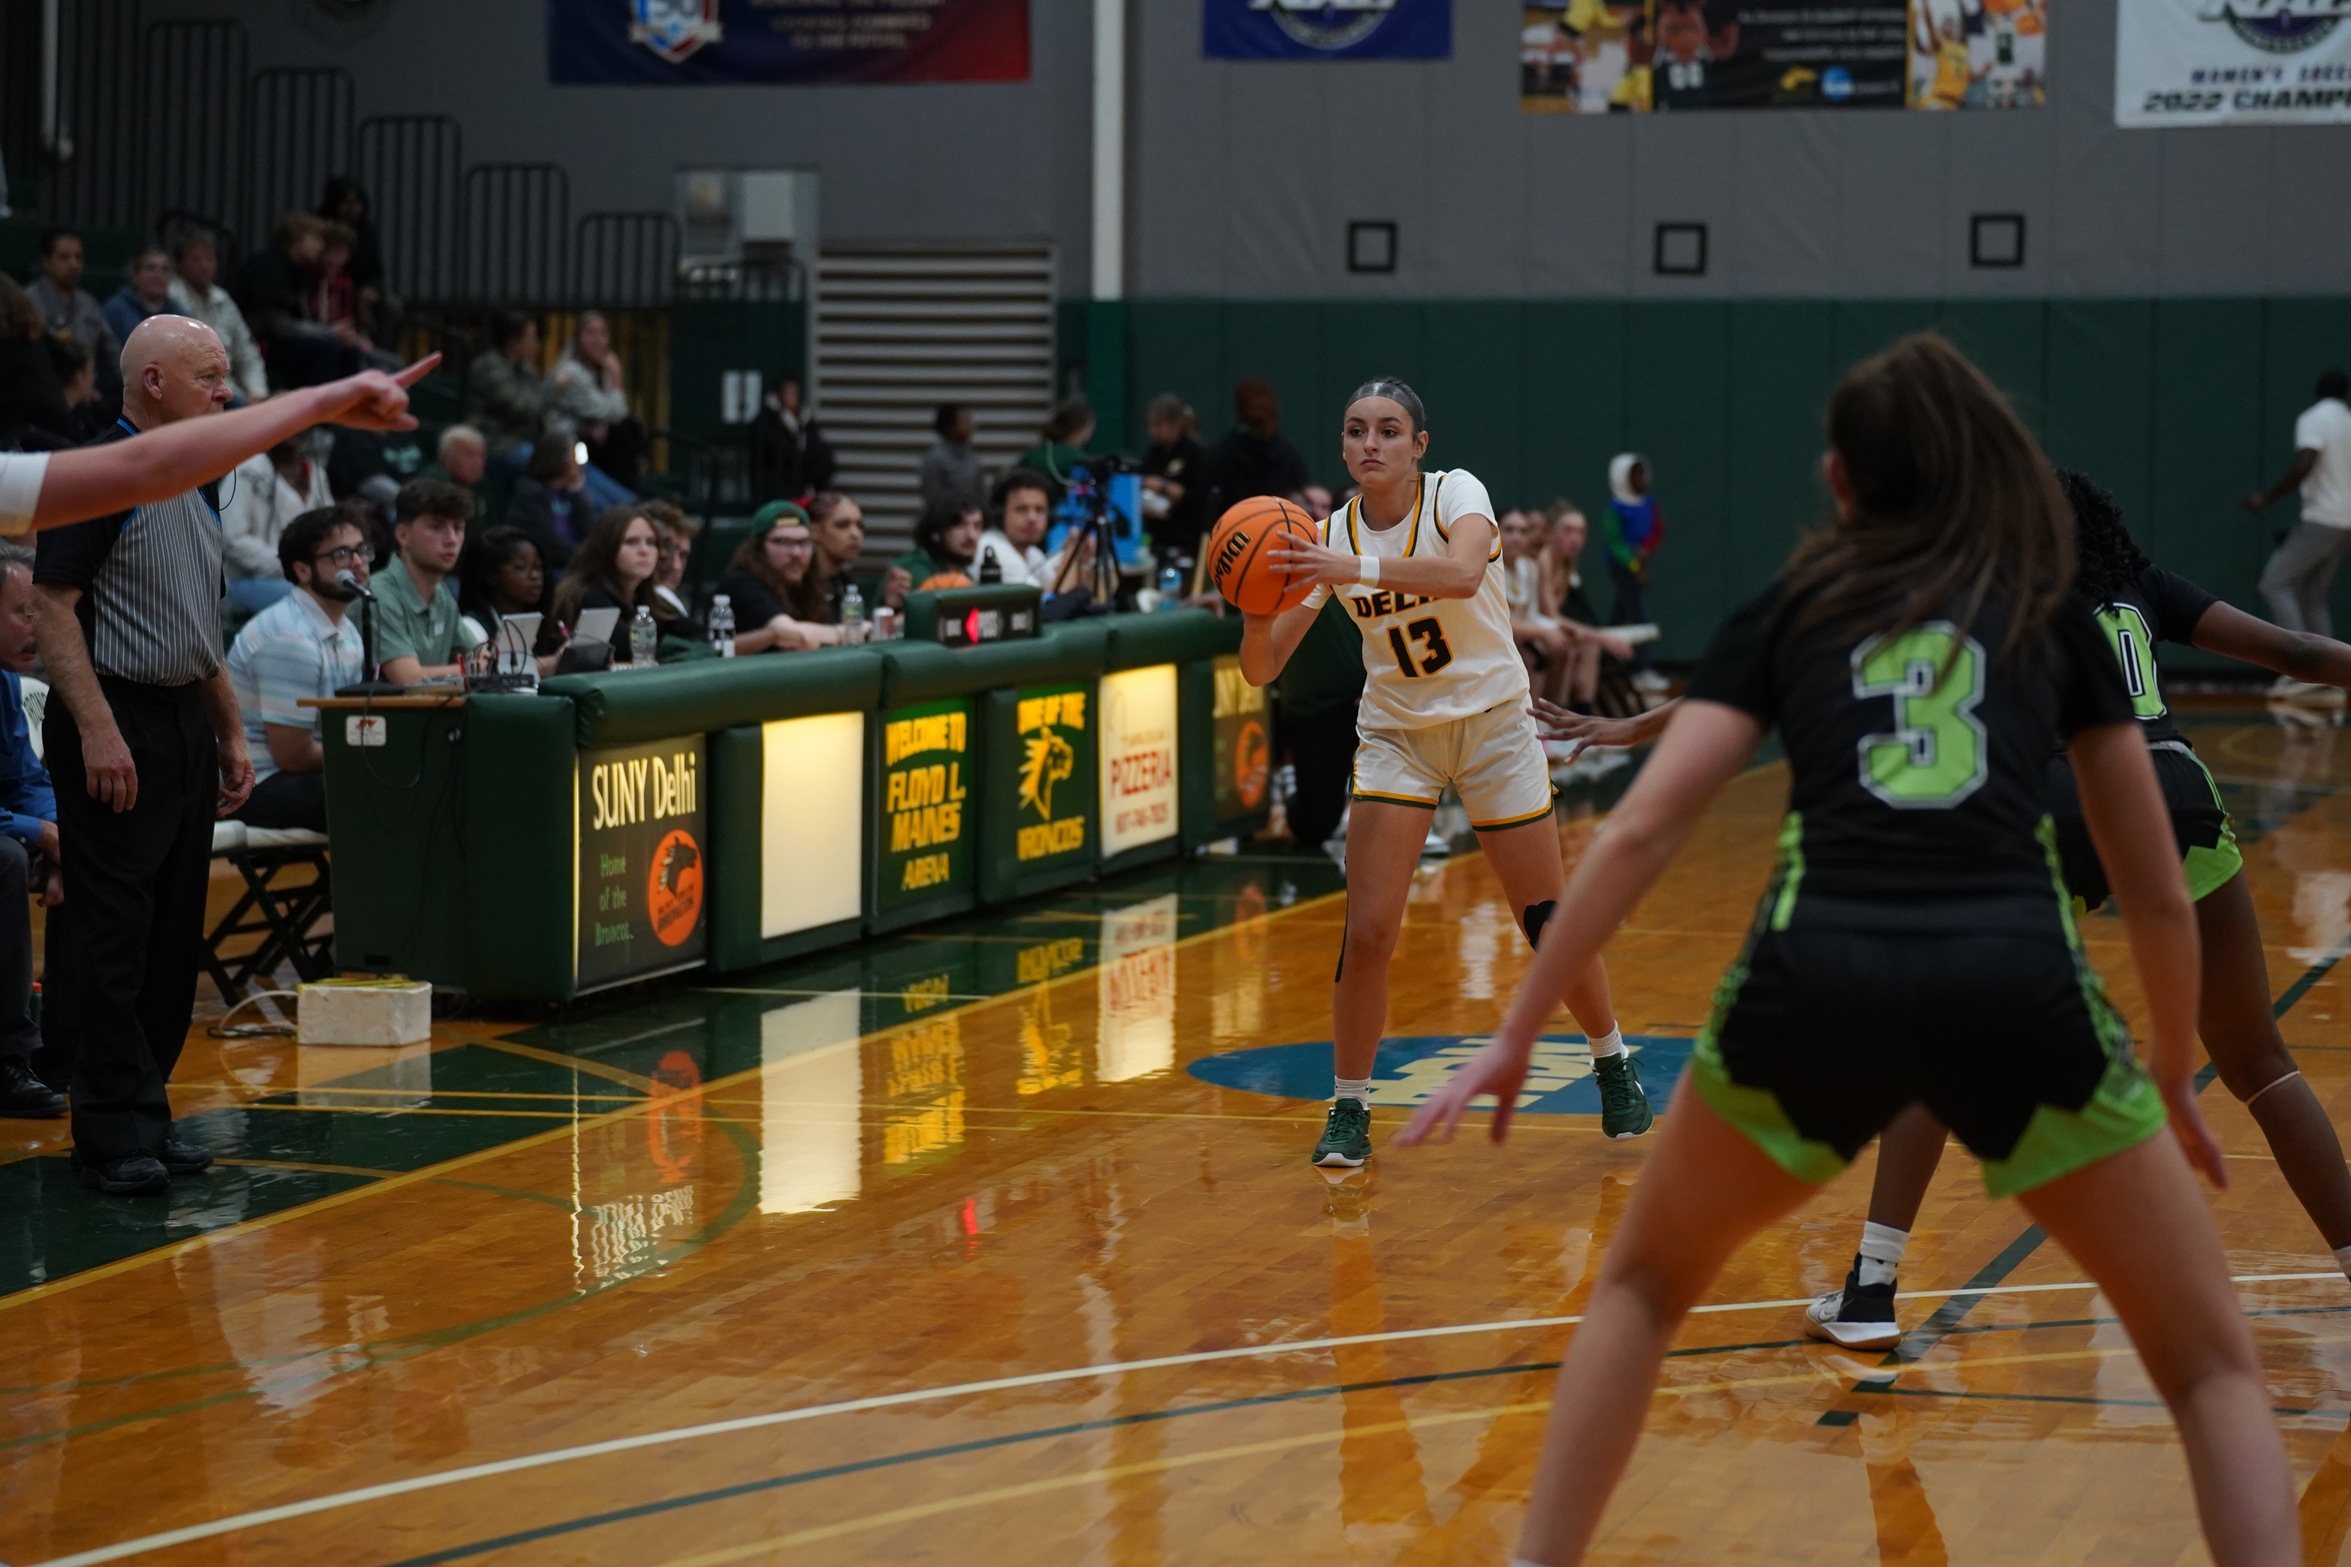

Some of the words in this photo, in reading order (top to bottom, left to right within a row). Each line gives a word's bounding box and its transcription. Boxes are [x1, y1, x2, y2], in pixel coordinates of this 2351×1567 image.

[2192, 65, 2283, 83] WOMEN'S
[2299, 63, 2351, 82] SOCC
[2143, 91, 2223, 112] 2022
[1387, 616, 1454, 677] 13
[885, 714, 949, 767] WELCOME
[949, 711, 967, 753] TO
[1850, 620, 1989, 811] 3
[591, 757, 649, 831] SUNY
[652, 750, 697, 821] Delhi
[886, 764, 946, 814] FLOYD
[948, 761, 967, 801] L.
[1111, 747, 1172, 799] PIZZERIA
[890, 801, 962, 854] MAINES
[600, 852, 627, 878] Home
[901, 852, 951, 891] ARENA
[599, 886, 611, 912] of
[612, 884, 627, 909] the
